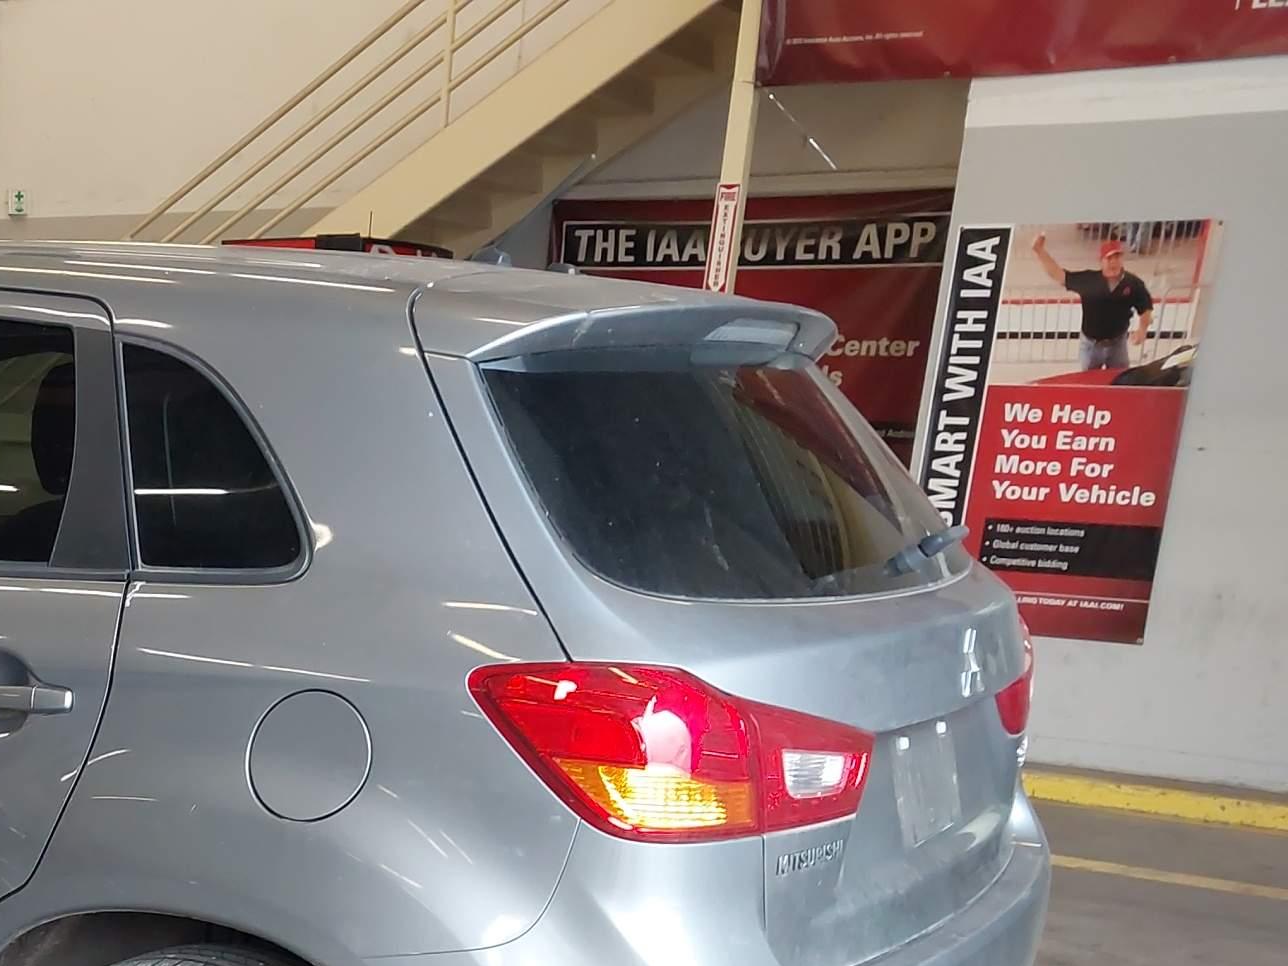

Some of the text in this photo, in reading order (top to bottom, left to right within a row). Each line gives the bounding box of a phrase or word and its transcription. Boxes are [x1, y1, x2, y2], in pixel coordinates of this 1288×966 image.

[574, 221, 937, 263] THE IAA UYER APP
[960, 236, 1001, 298] IAA
[826, 334, 921, 358] Center
[942, 310, 989, 402] WITH
[1003, 402, 1112, 429] We Help
[1000, 429, 1116, 452] You Earn
[994, 454, 1114, 478] More For
[991, 480, 1157, 507] Your Vehicle
[1015, 525, 1046, 535] auction
[1046, 526, 1085, 537] locations
[992, 539, 1080, 553] Global customer base
[989, 555, 1069, 571] Competitive bidding
